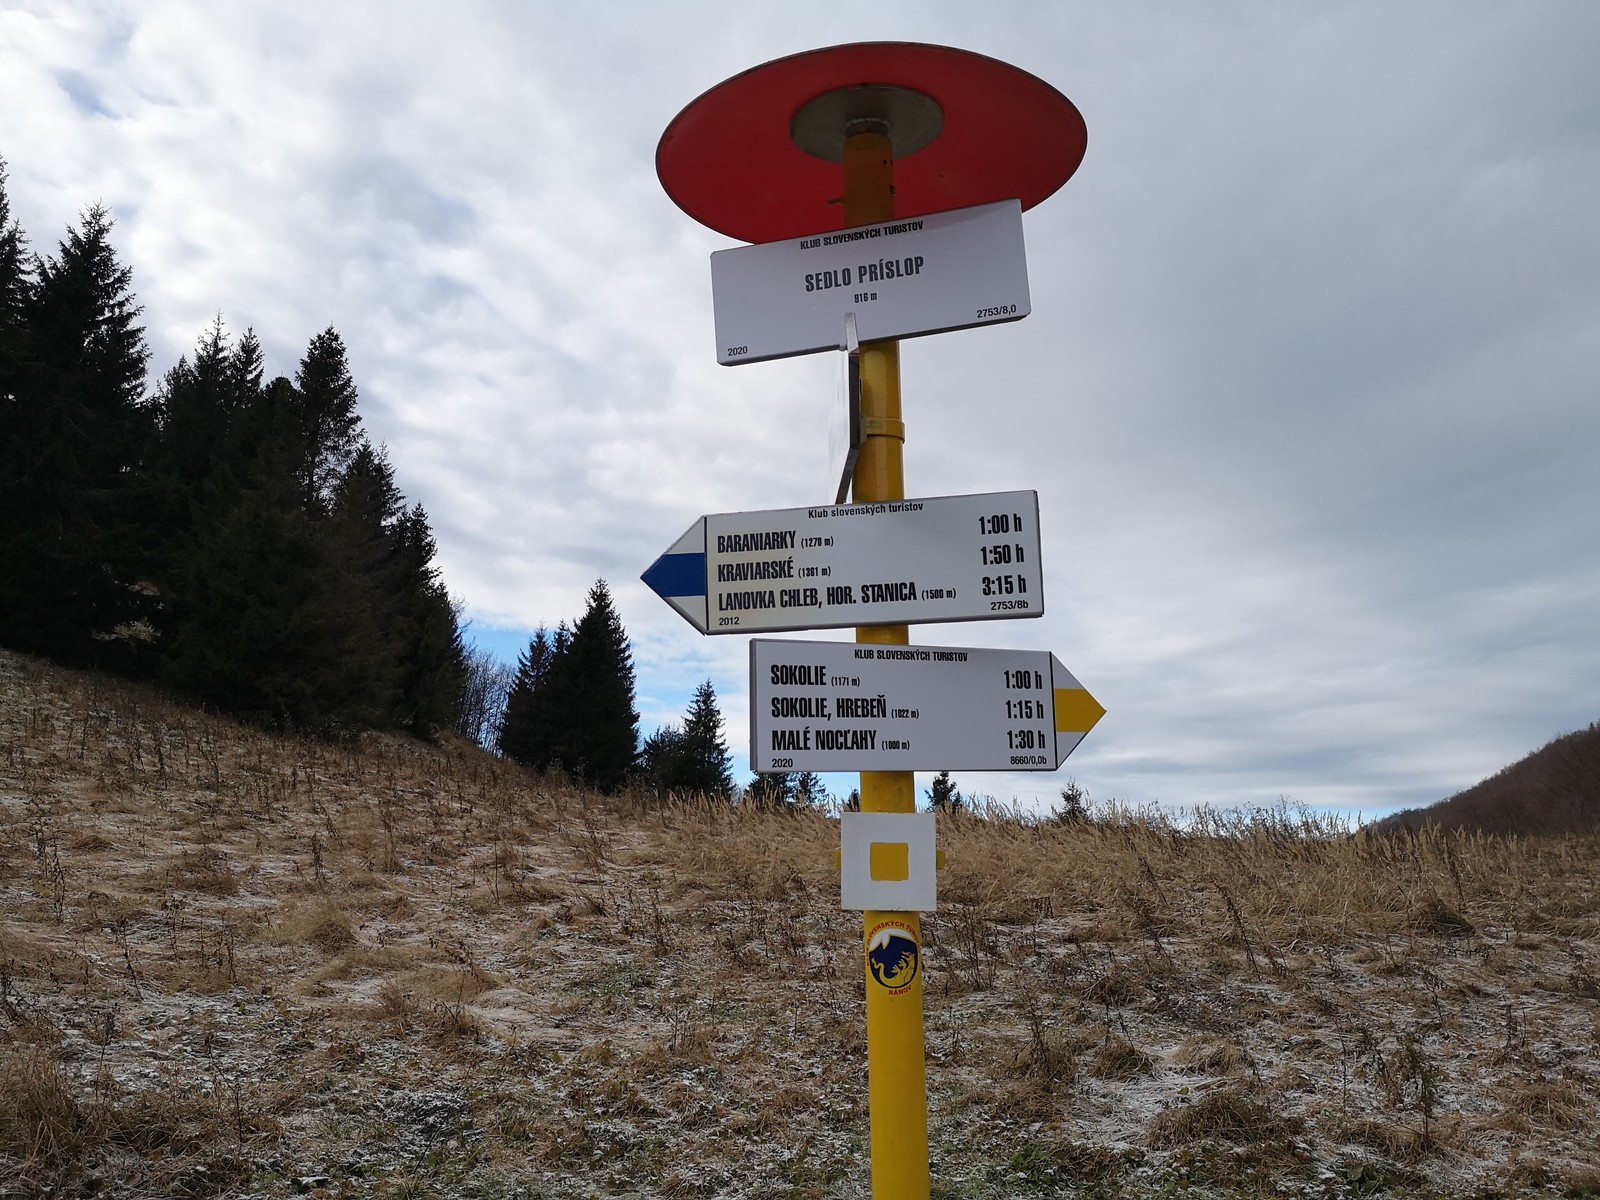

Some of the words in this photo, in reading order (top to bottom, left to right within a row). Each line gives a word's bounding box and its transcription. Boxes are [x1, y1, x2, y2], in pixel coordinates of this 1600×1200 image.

[800, 239, 820, 250] KLUB
[824, 228, 880, 246] SLOVENSKÝCH
[884, 221, 923, 236] TURISTOV
[805, 268, 852, 292] SEDLO
[858, 256, 924, 284] PRÍSLOP
[854, 292, 868, 303] 916
[870, 292, 878, 300] m
[976, 304, 1017, 318] 2753/8,0
[728, 346, 748, 356] 2020
[808, 509, 828, 518] Klub
[832, 502, 886, 517] slovenských
[889, 502, 923, 512] turistov
[978, 514, 1009, 534] 1:00
[1014, 514, 1022, 532] h
[718, 530, 796, 553] BARANIARKY
[801, 538, 822, 549] (1270
[824, 536, 834, 547] m)
[980, 544, 1012, 565] 1:50
[1016, 544, 1024, 562] h
[718, 556, 794, 582] KRAVIARSKÉ
[798, 568, 818, 578] (1361
[822, 566, 831, 576] m)
[982, 575, 1014, 596] 3:15
[1018, 574, 1026, 593] h
[718, 590, 776, 611] LANOVKA
[780, 588, 822, 608] CHLEB,
[827, 586, 856, 605] HOR.
[861, 582, 917, 603] STANICA
[922, 589, 944, 600] (1500
[946, 588, 956, 599] m)
[990, 600, 1028, 610] 2753/8b
[719, 617, 740, 626] 2012
[854, 650, 874, 660] KLUB
[877, 649, 930, 660] SLOVENSKÝCH
[932, 652, 968, 662] TURISTOV
[771, 664, 826, 686] SOKOLIE
[832, 677, 850, 687] (1171
[852, 677, 860, 687] m)
[1004, 670, 1032, 689] 1:00
[1034, 671, 1042, 689] h
[772, 697, 832, 721] SOKOLIE,
[836, 694, 886, 718] HREBEŇ
[892, 709, 910, 719] (1022
[911, 709, 919, 718] m)
[1006, 700, 1032, 719] 1:15
[1036, 700, 1044, 718] h
[772, 726, 810, 750] MALÉ
[902, 740, 910, 750] m)
[1007, 730, 1034, 749] 1:30
[1038, 730, 1046, 748] h
[772, 758, 794, 768] 2020
[1010, 756, 1046, 766] 8660/0,0b
